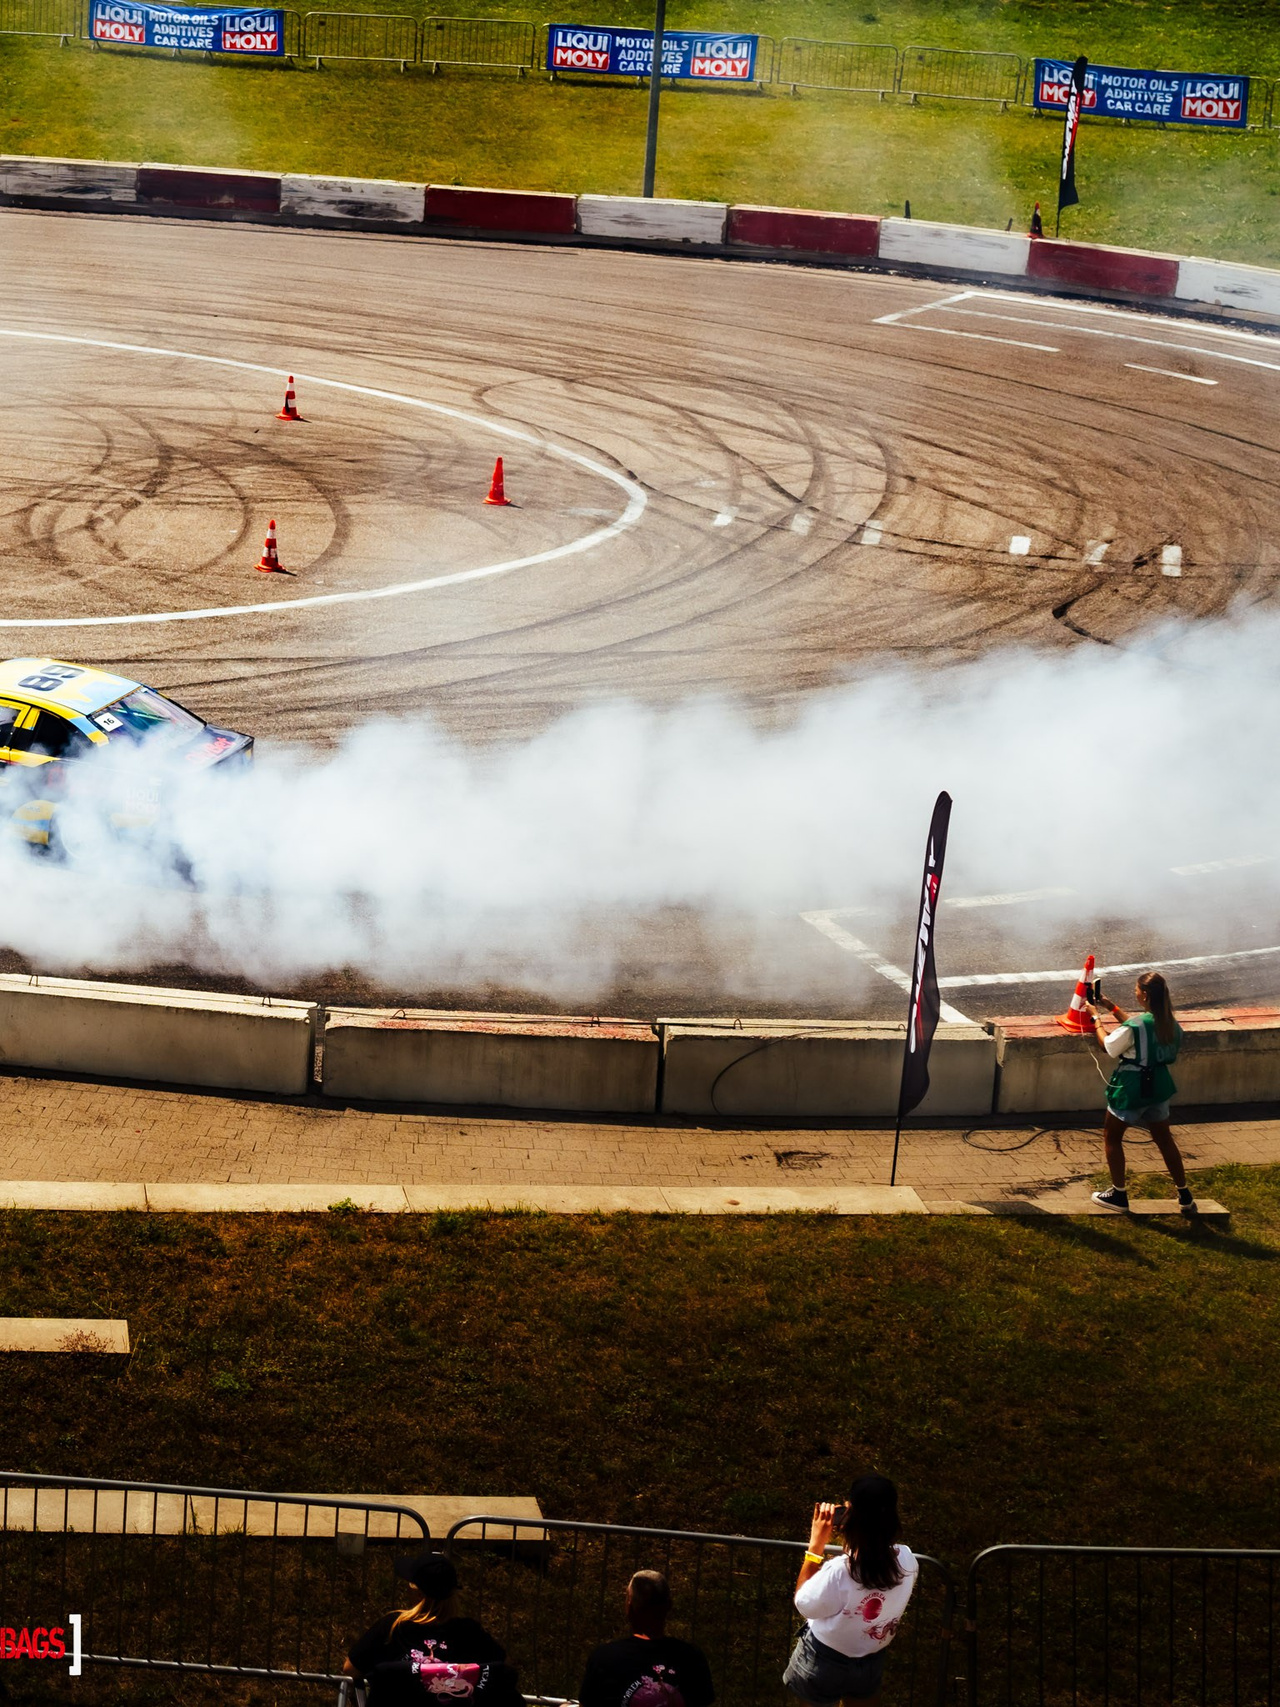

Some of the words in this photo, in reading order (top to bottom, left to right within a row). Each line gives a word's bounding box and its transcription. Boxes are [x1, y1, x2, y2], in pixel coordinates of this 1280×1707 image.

[96, 3, 143, 25] LIQUI
[149, 11, 189, 26] MOTOR
[192, 14, 219, 26] OILS
[96, 21, 143, 42] MOLY
[152, 23, 215, 38] ADDITIVES
[225, 14, 275, 33] LIQUI
[154, 36, 179, 47] CAR
[180, 37, 213, 49] CARE
[225, 33, 277, 50] MOLY
[556, 31, 609, 51] LIQUI
[555, 49, 608, 69] MOLY
[695, 41, 748, 60] LIQUI
[619, 61, 645, 72] CAR
[694, 59, 748, 77] MOLY
[1100, 73, 1147, 90] MOTOR
[1149, 78, 1179, 92] OILS
[1185, 81, 1239, 99] LIQUI
[1042, 83, 1095, 105] MOY
[1104, 87, 1173, 103] ADDITIVES
[1107, 99, 1133, 112] CAR
[1137, 103, 1170, 116] CARE
[1183, 99, 1239, 118] MOLY
[103, 717, 115, 726] 16
